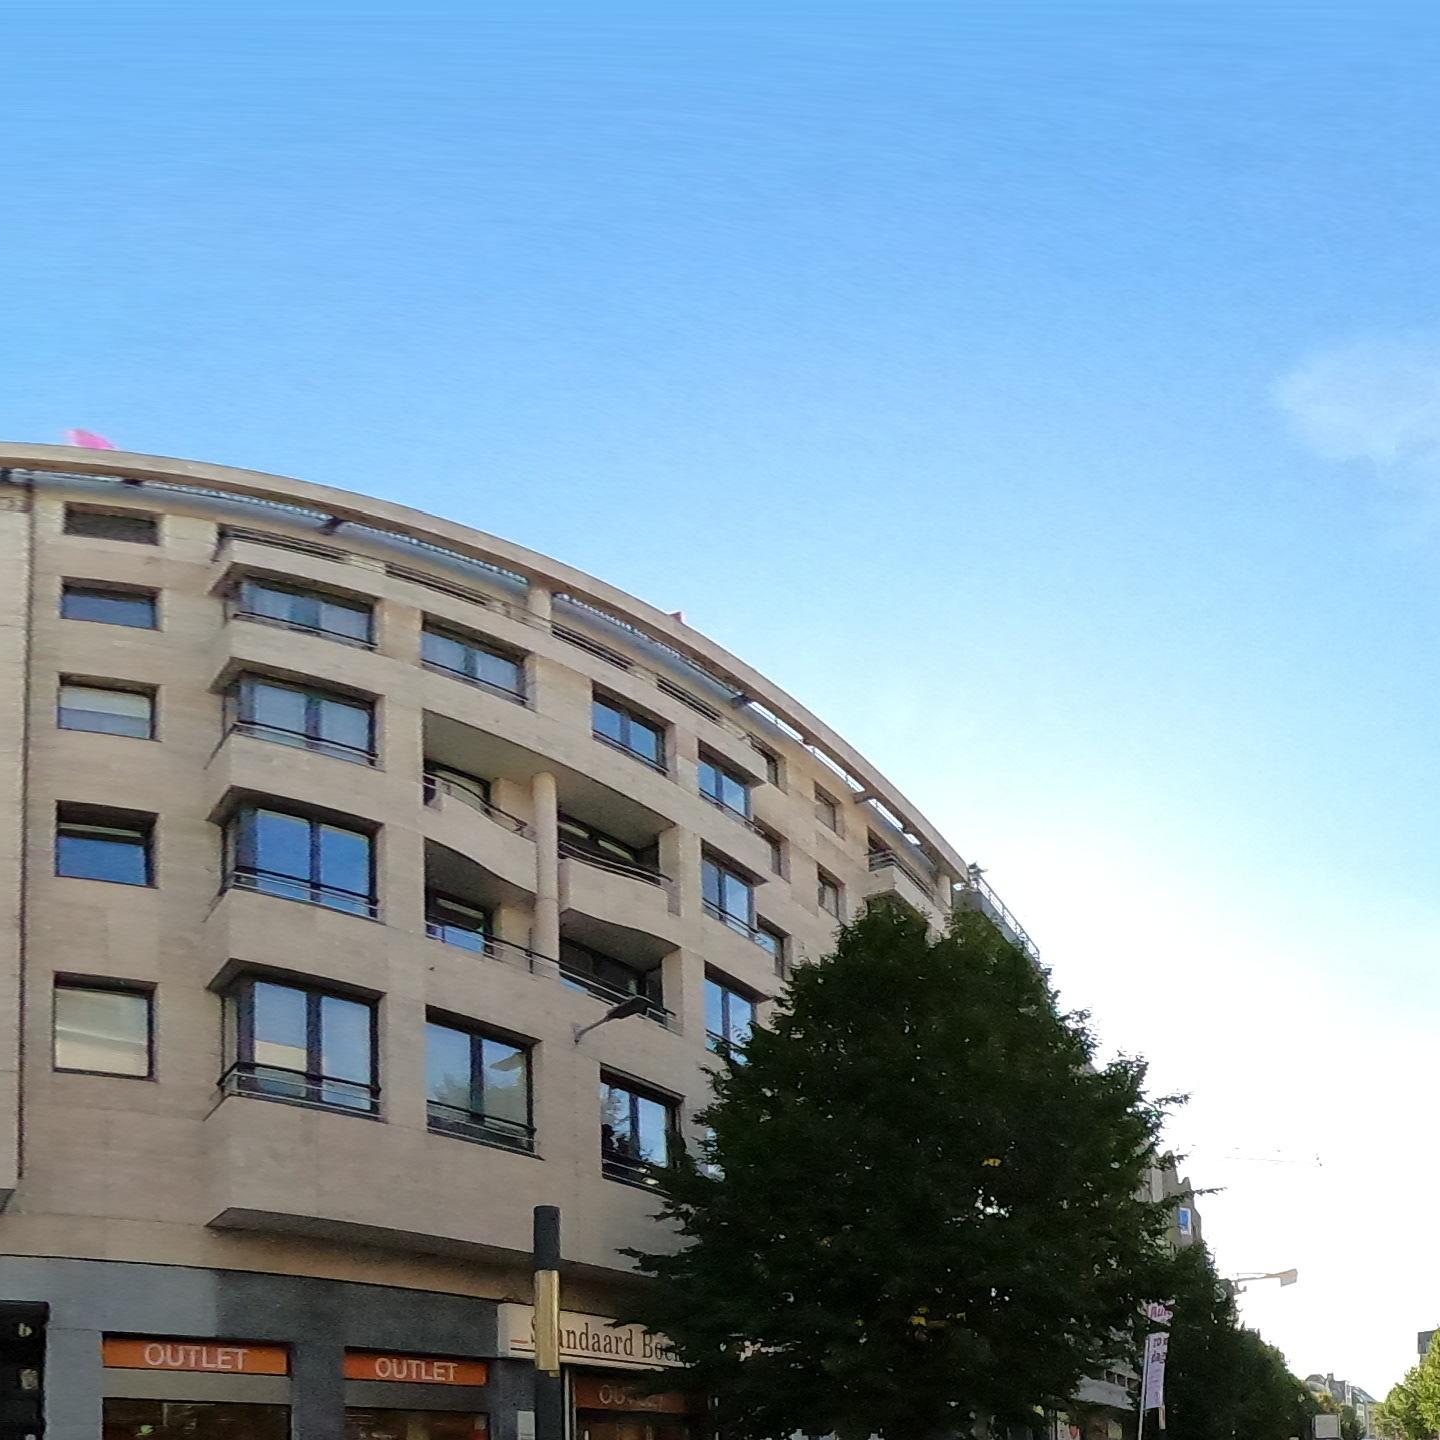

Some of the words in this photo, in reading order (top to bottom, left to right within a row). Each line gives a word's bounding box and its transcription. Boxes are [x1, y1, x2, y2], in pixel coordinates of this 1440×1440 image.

[530, 1314, 635, 1358] ndaard
[143, 1342, 250, 1371] OUTLET
[374, 1357, 460, 1382] OUTLET
